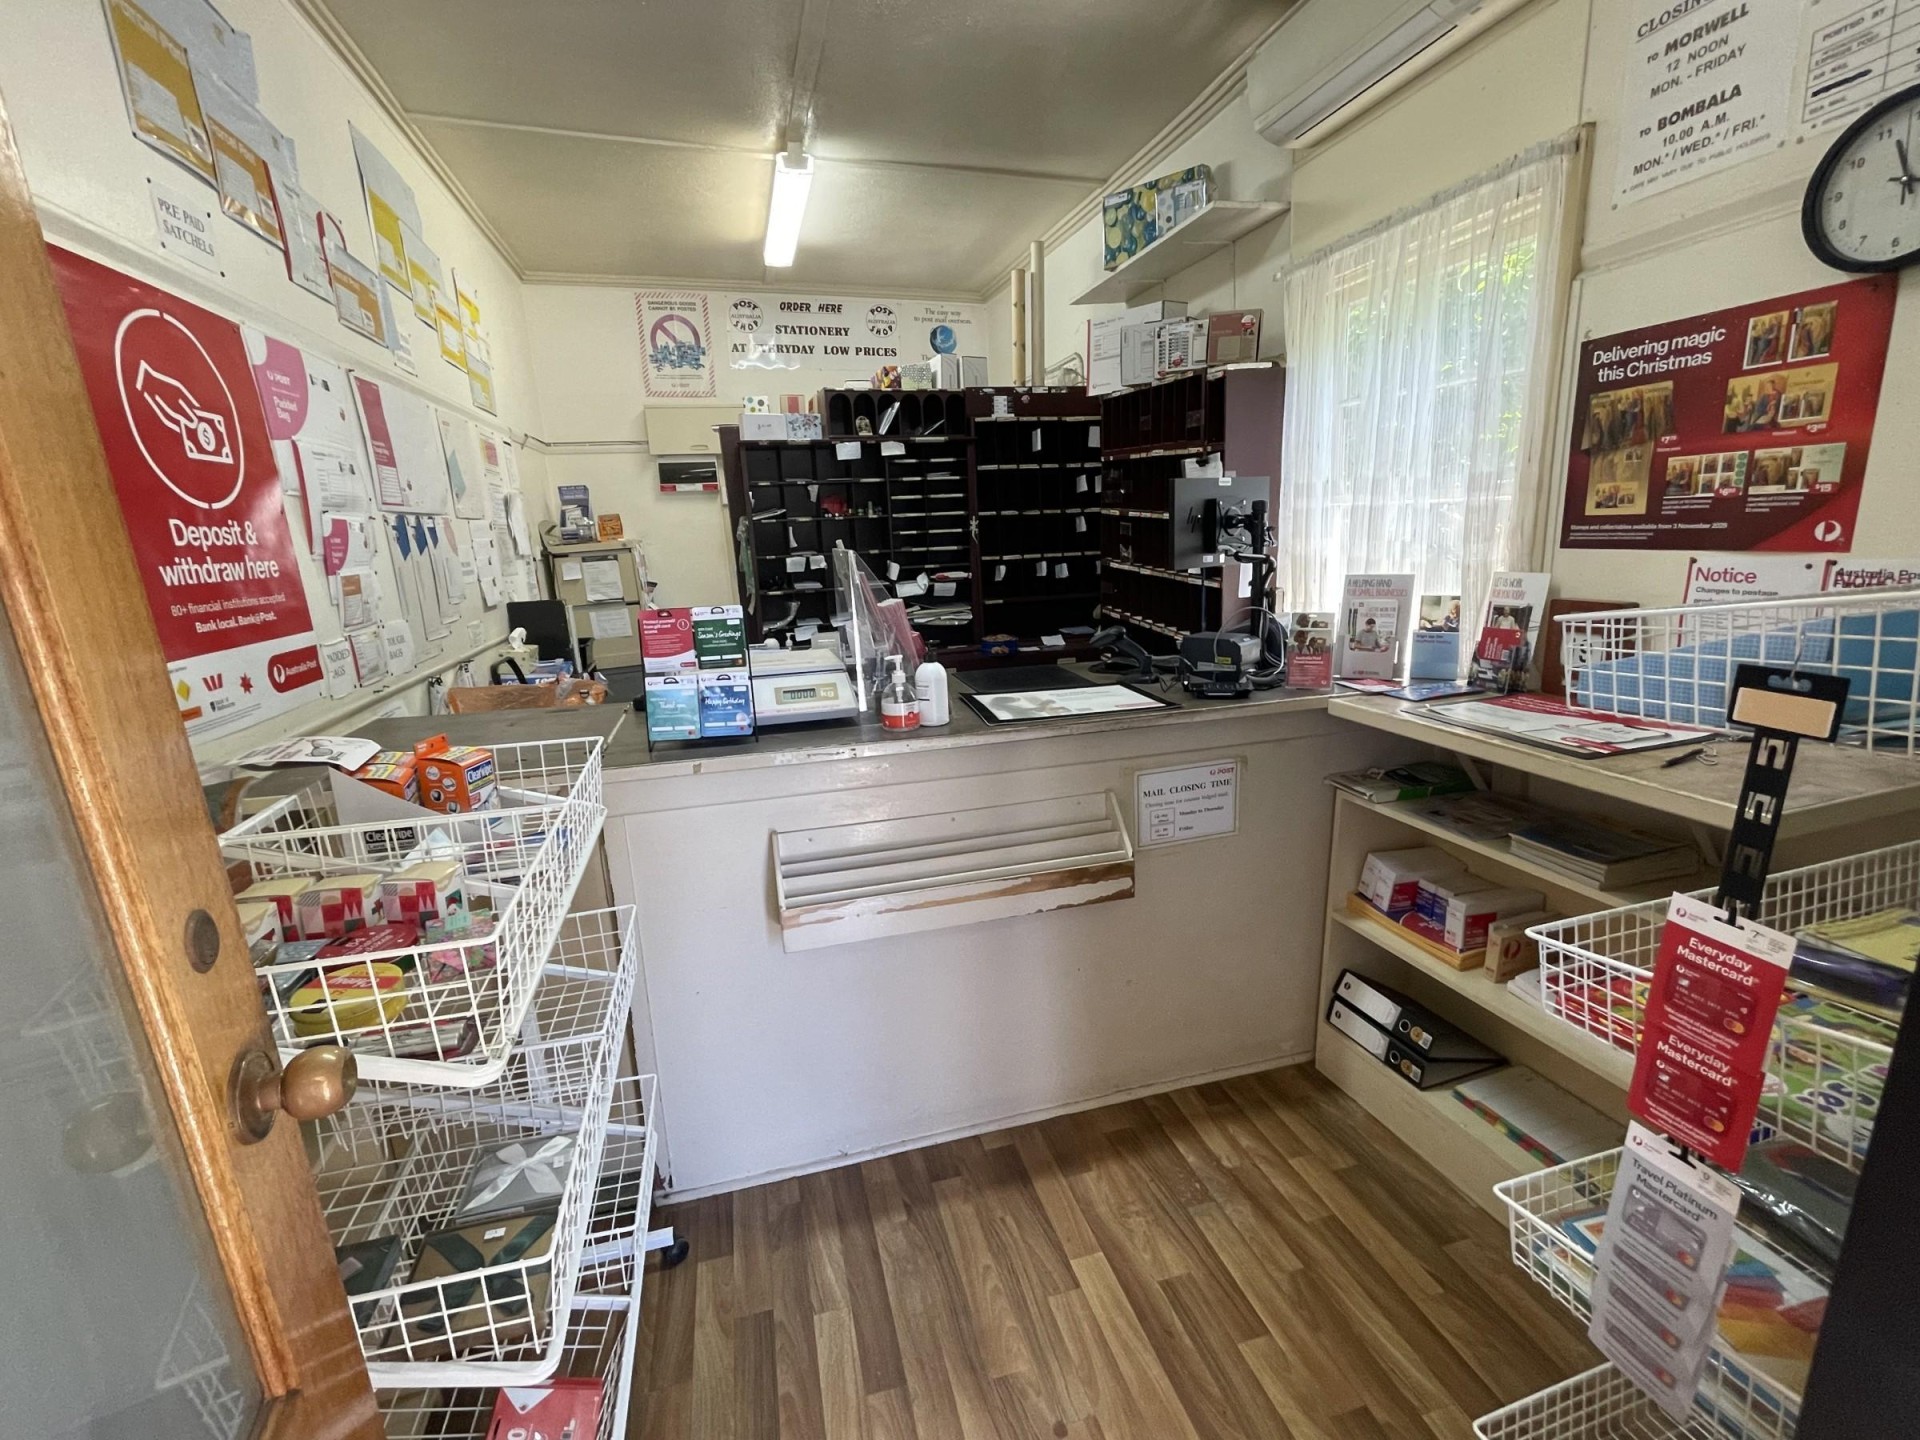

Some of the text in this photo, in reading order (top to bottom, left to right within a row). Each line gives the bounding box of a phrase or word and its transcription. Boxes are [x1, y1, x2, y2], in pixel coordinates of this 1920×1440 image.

[1664, 3, 1749, 57] MORWELL
[1666, 34, 1729, 73] 12 NOON
[1650, 75, 1683, 98] MON.
[1695, 43, 1746, 77] FRIDAY
[1657, 84, 1742, 132] BOMBALA
[1663, 112, 1730, 147] 10.00 A.M.
[1878, 128, 1892, 141] 11
[1850, 157, 1866, 170] 10
[1834, 191, 1843, 203] 9
[157, 197, 205, 233] PRE PAID
[1838, 219, 1847, 230] 8
[162, 219, 215, 257] SATCHELS
[1859, 235, 1868, 247] 7
[1891, 237, 1900, 248] 6
[732, 300, 759, 311] POST
[779, 302, 843, 314] ORDER HERE
[870, 306, 893, 316] POST
[733, 320, 759, 331] SHOP
[775, 325, 850, 337] STATIONERY
[869, 324, 893, 336] SHOP
[731, 343, 897, 357] AT LOW PRICES
[1593, 326, 1727, 366] Delivering magic
[1597, 351, 1713, 382] this Christmas
[168, 518, 259, 551] Deposit &
[159, 555, 280, 587] withdraw here
[1695, 567, 1757, 584] Notice
[1376, 579, 1393, 587] HAND
[1695, 586, 1730, 596] Changes
[188, 599, 222, 614] financial
[223, 596, 259, 609] institutions
[259, 592, 286, 605] accepted
[195, 620, 218, 633] Bank
[286, 659, 317, 677] Australia Post
[820, 688, 835, 698] kg
[1143, 778, 1232, 798] MAIL CLOSING TIME
[1689, 937, 1752, 972] Everyday
[1668, 1034, 1730, 1073] Everyday
[1633, 1157, 1717, 1220] Travel Platinum
[1636, 1174, 1700, 1222] Mastercard
